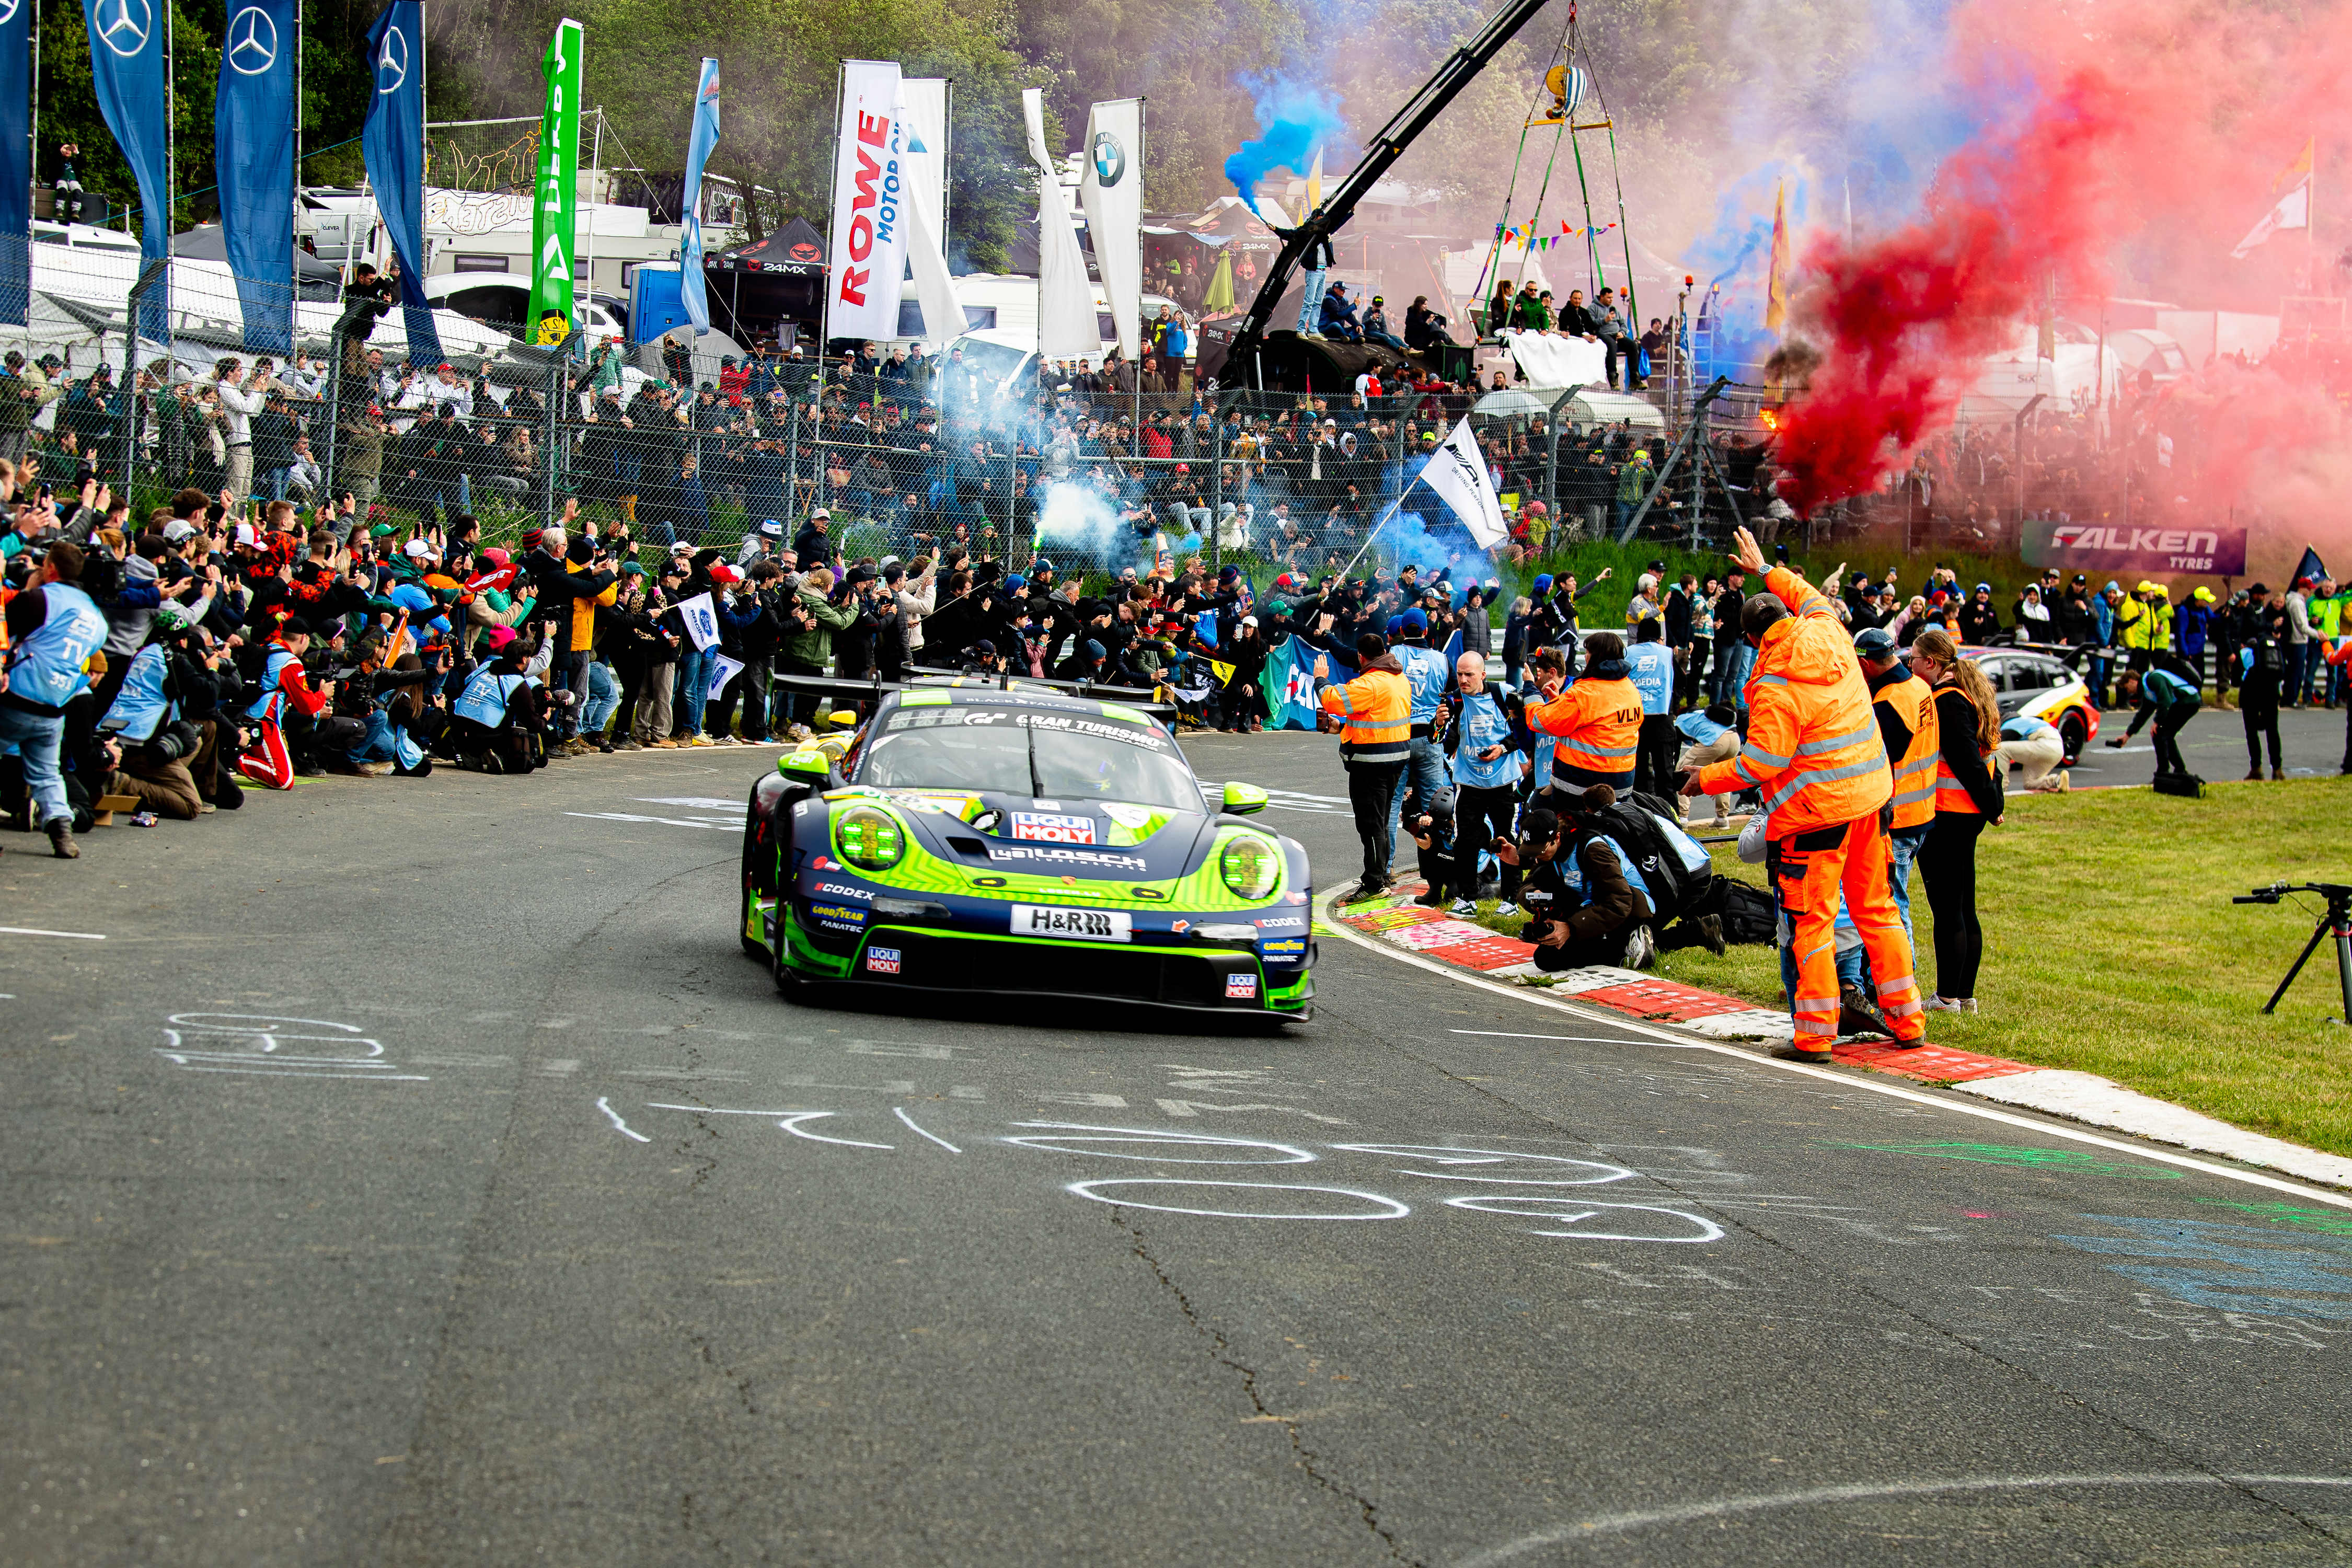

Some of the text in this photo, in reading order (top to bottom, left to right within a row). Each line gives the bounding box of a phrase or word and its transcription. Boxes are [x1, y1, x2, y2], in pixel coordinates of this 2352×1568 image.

[839, 110, 889, 308] ROWE
[764, 262, 807, 274] 24MX
[1451, 466, 1469, 489] DRIVING
[2051, 526, 2219, 555] FALKEN
[2169, 556, 2212, 570] TYRES
[689, 609, 704, 642] RACING
[63, 637, 93, 664] TV
[49, 671, 73, 691] 351
[473, 681, 491, 697] TV
[1633, 677, 1661, 687] MEDIA
[1030, 701, 1087, 711] FALCON
[1616, 707, 1640, 724] VLN
[1016, 714, 1073, 728] GRAN
[1075, 720, 1163, 747] TURISMO
[1018, 814, 1090, 830] LIQUI
[1019, 825, 1091, 844] MOLY
[823, 883, 875, 901] CODEX
[812, 906, 864, 921] GOODYEAR
[821, 920, 864, 933] FANATEC
[1262, 917, 1304, 928] CODEX
[870, 948, 898, 961] LIQUI
[869, 959, 900, 971] MOLY
[1229, 975, 1256, 986] LIQUI
[1227, 986, 1254, 996] MOLY
